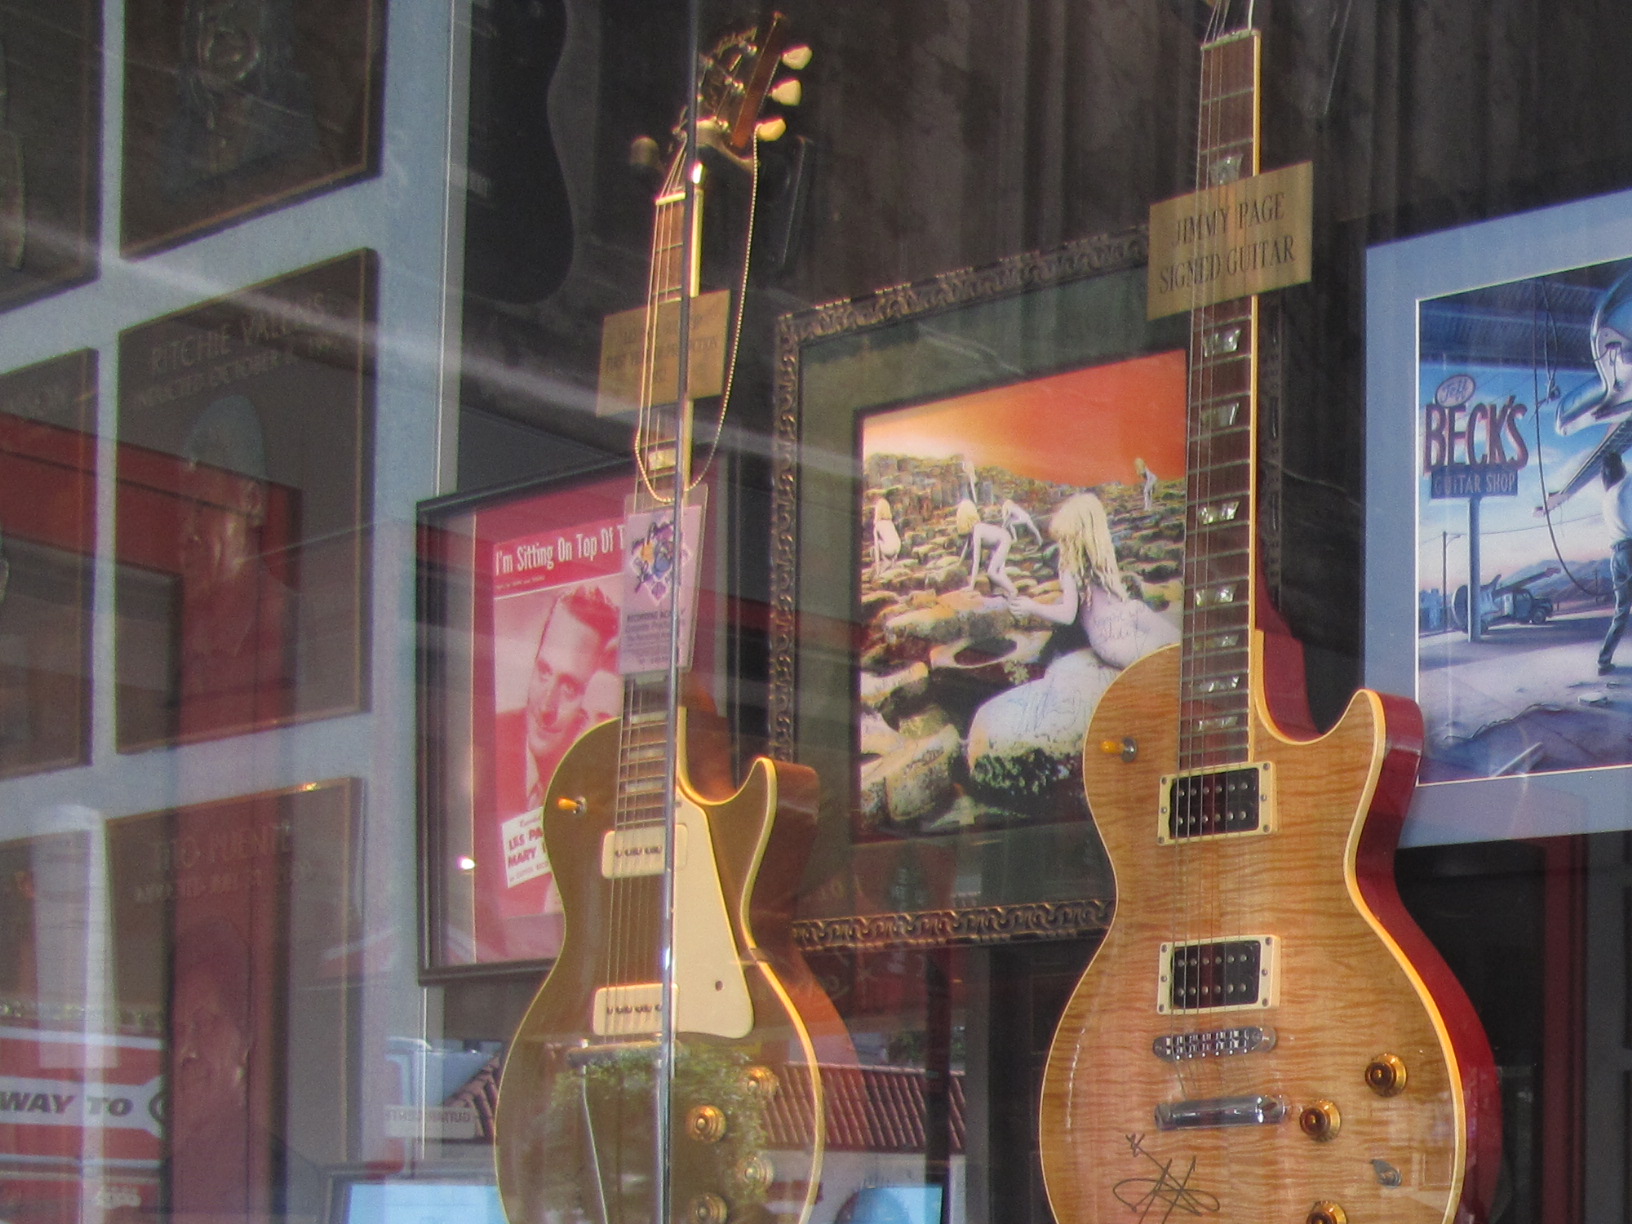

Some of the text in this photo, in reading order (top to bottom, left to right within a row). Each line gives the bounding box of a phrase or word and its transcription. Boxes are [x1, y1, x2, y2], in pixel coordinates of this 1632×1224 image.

[1171, 191, 1286, 247] JIMMY PAGE
[1159, 235, 1295, 294] SIGNED GUITAR
[1424, 395, 1529, 475] BECK'S
[1434, 472, 1516, 495] GUITAR SHOP
[495, 550, 514, 576] I'm
[517, 541, 555, 571] Sitting
[558, 537, 573, 562] On
[576, 533, 598, 561] Top
[601, 528, 614, 553] Of
[509, 826, 544, 852] LES PA
[86, 1096, 134, 1117] TO
